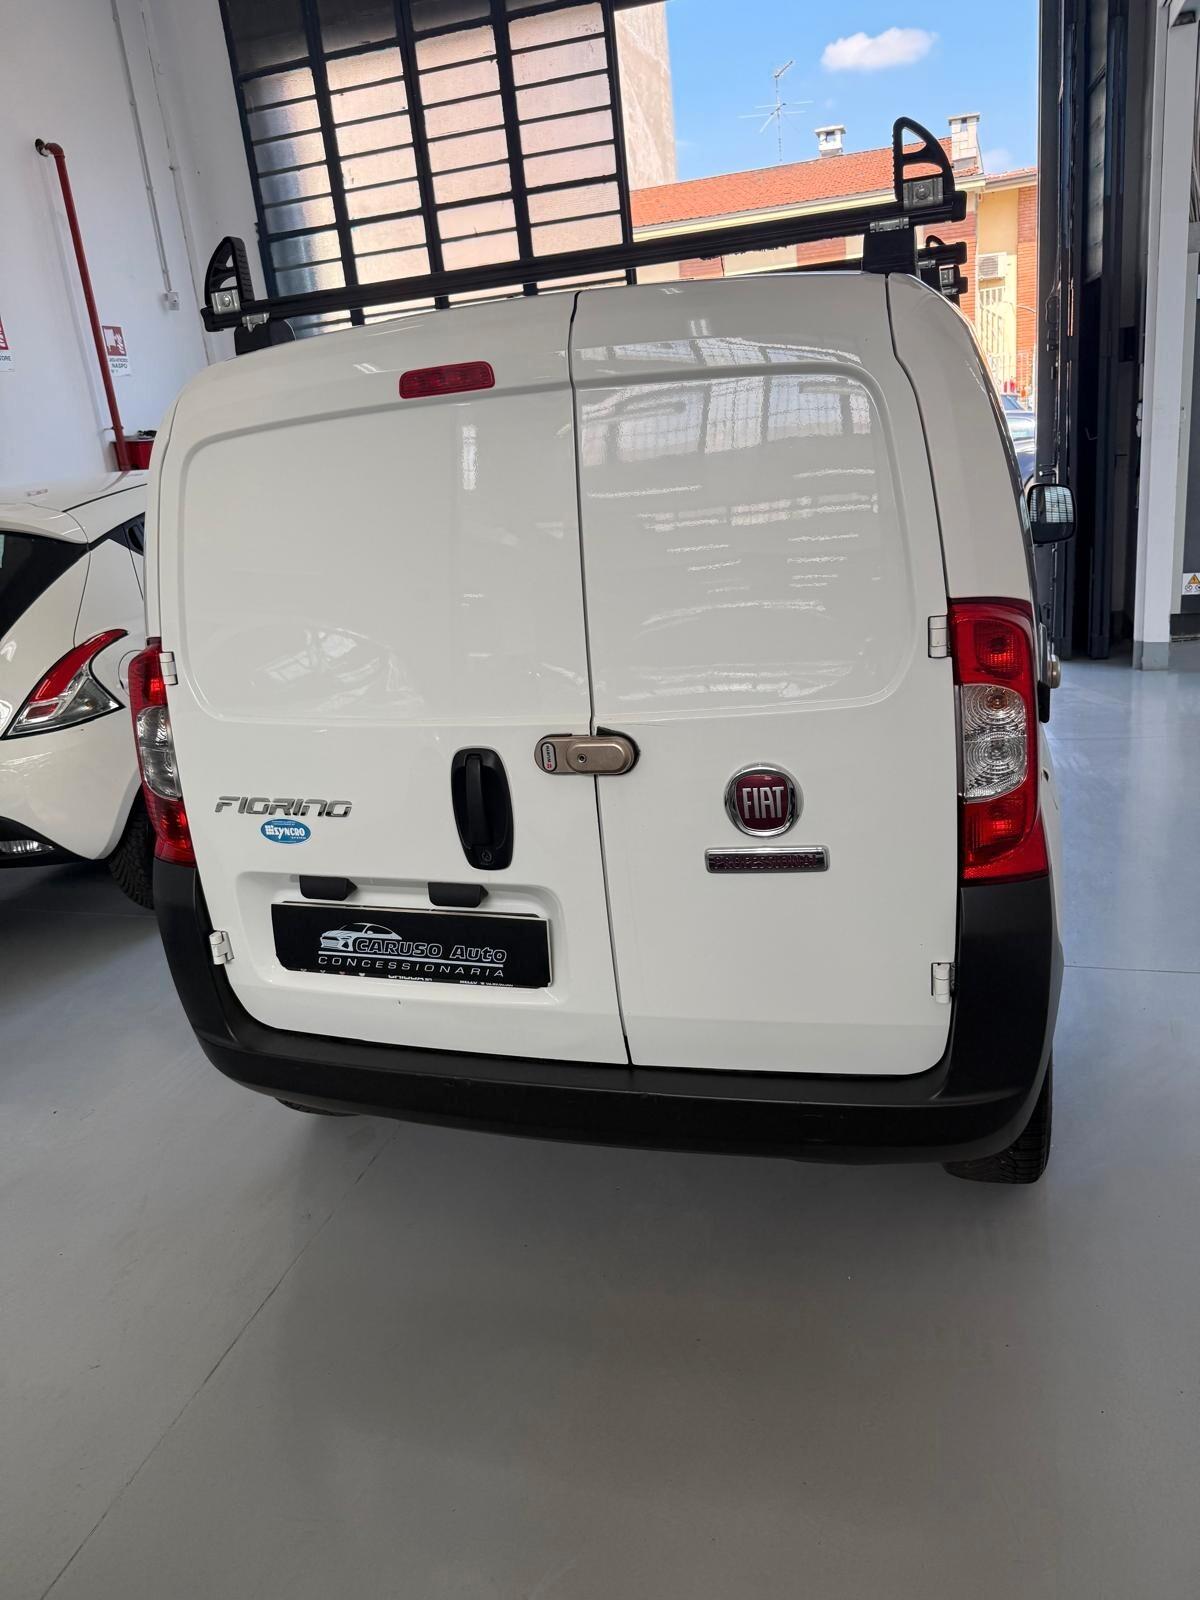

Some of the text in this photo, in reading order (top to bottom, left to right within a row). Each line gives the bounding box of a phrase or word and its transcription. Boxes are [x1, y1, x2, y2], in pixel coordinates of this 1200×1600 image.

[214, 795, 353, 818] FIORINO
[742, 786, 785, 819] FIAT
[273, 826, 306, 839] SYNCRO
[355, 938, 508, 963] CARUSO Auto
[317, 955, 505, 978] CONCESSIONARIA
